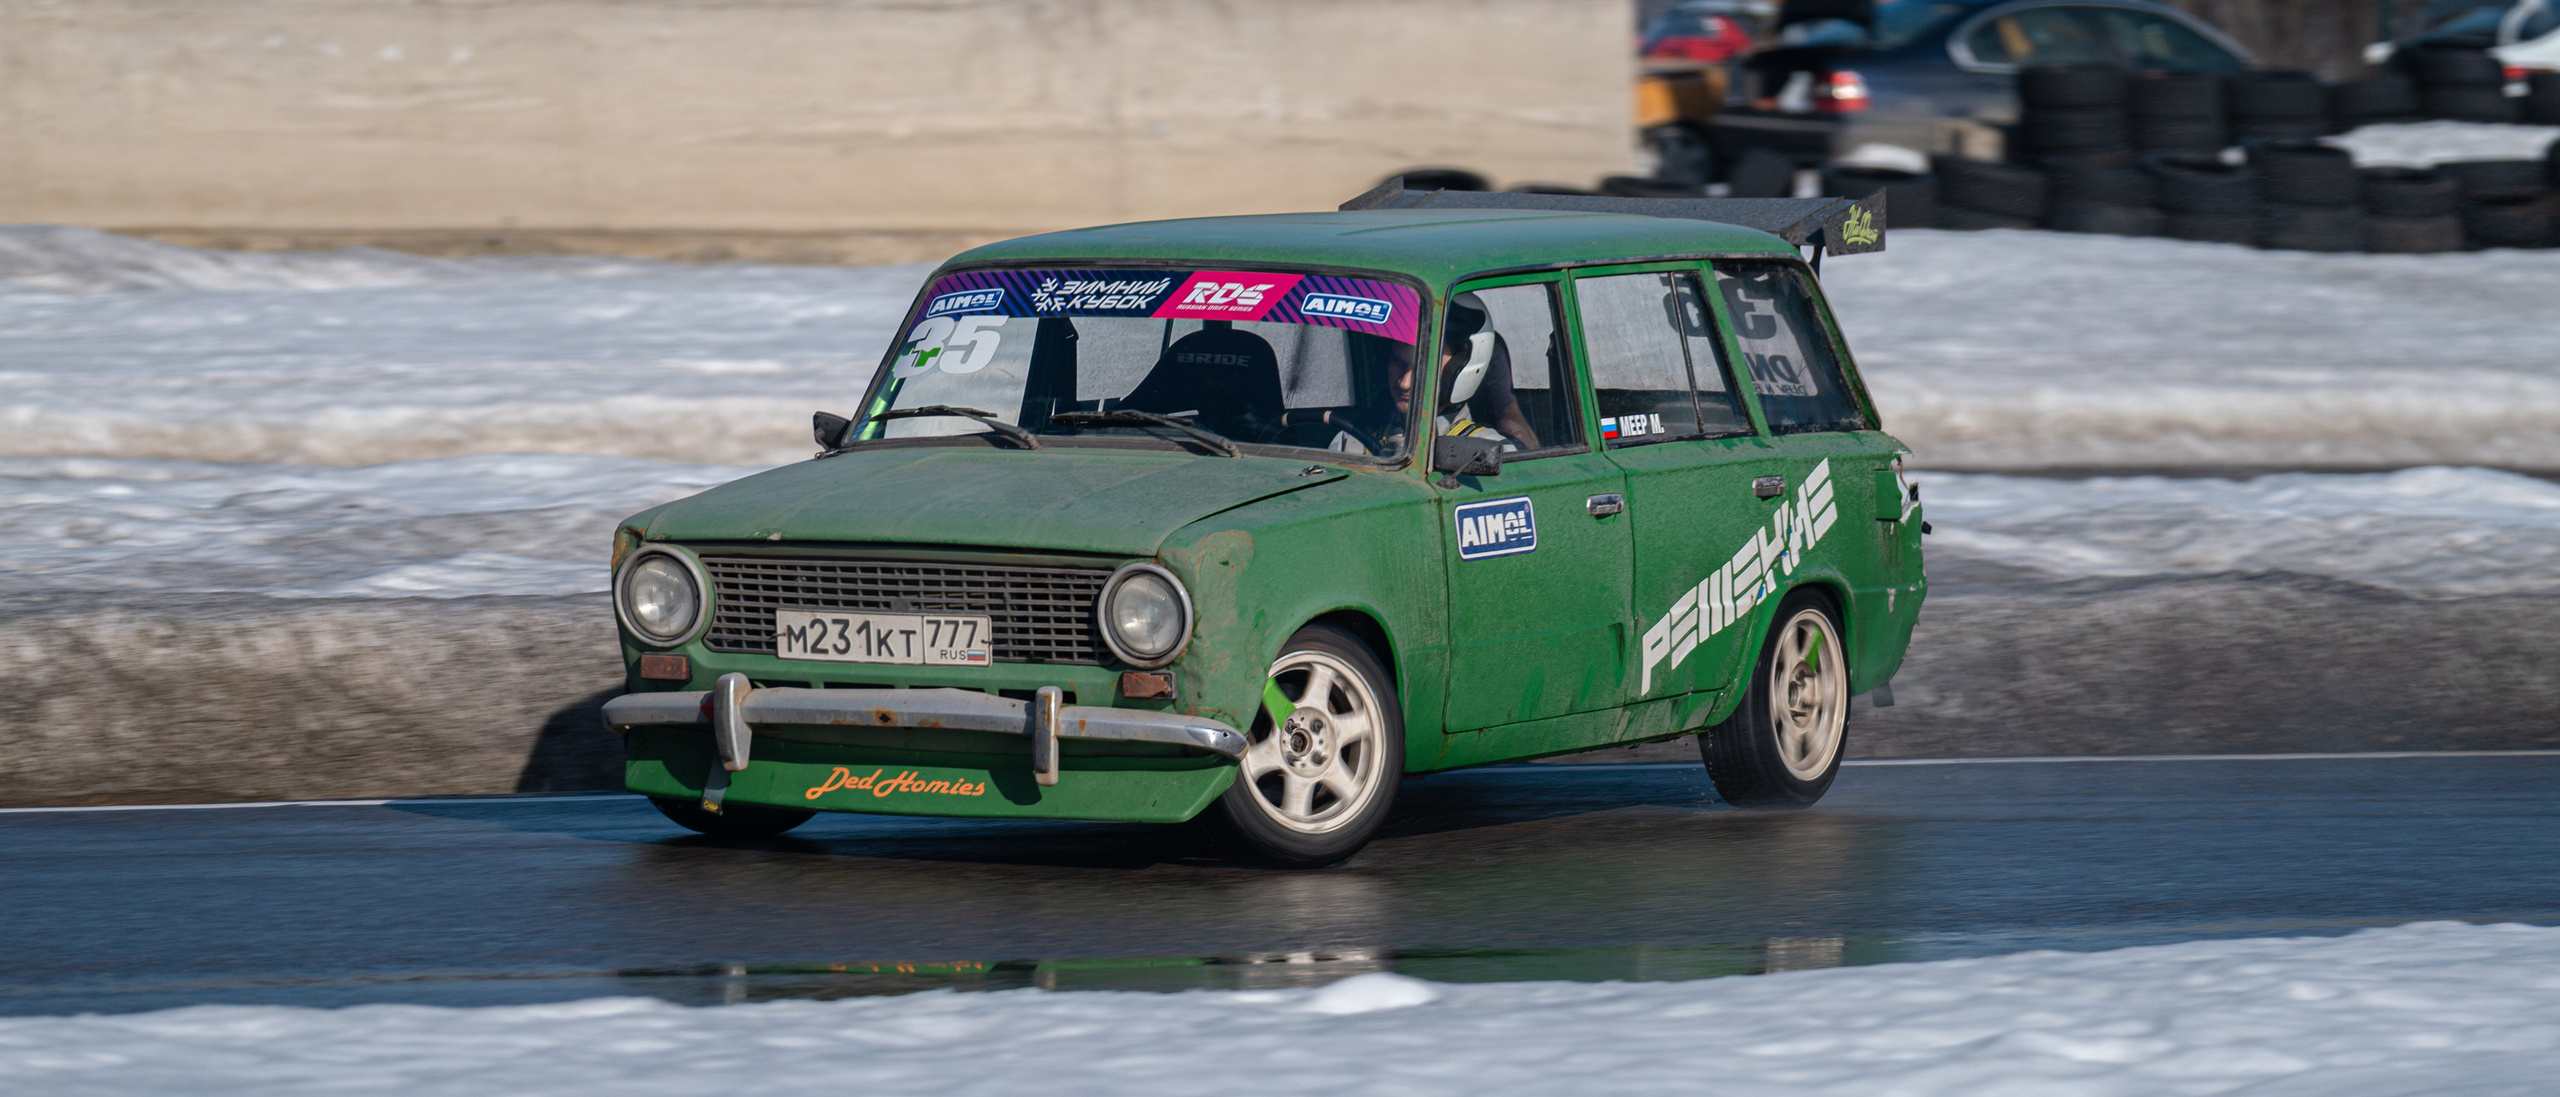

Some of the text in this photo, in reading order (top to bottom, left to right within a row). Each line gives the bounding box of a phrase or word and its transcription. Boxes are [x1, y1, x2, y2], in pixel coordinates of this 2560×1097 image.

[1056, 277, 1171, 295] ЗИМНИЙ
[1182, 282, 1275, 306] RDS
[930, 292, 998, 313] AIMOL
[1066, 295, 1157, 309] КУБОК
[1176, 303, 1207, 311] RUSSIAN
[1304, 298, 1385, 319] AIMOL
[893, 315, 1009, 378] 35
[1176, 352, 1252, 367] BRIDE
[1462, 510, 1533, 548] AIMOL
[926, 619, 978, 648] 777
[940, 650, 966, 660] RUS
